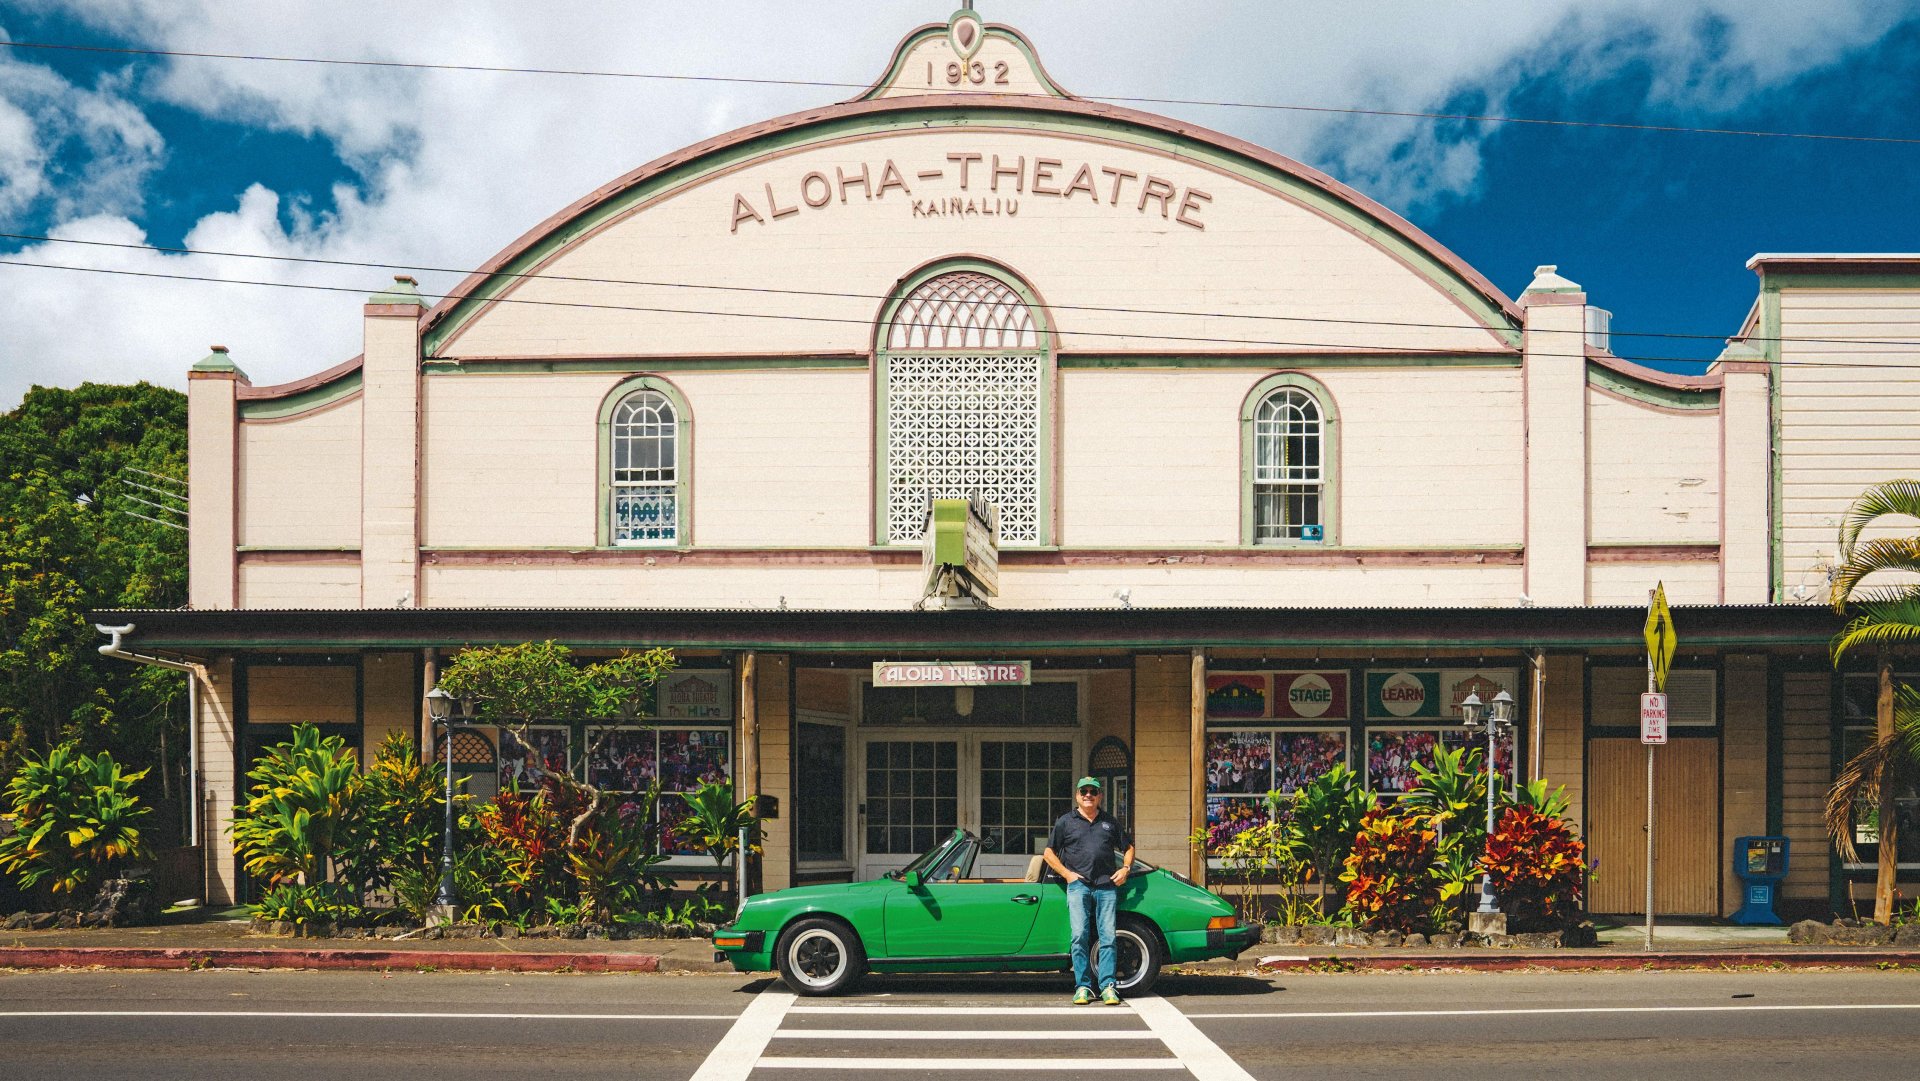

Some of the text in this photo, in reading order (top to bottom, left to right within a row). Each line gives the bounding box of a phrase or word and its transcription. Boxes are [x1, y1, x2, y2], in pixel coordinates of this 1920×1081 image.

[927, 61, 1009, 85] 1932
[911, 197, 1019, 218] KAINALIU
[886, 666, 1018, 682] ALOHA THEATRE
[1289, 688, 1331, 702] STAGE
[1381, 687, 1424, 701] LEARN
[1649, 698, 1659, 708] NO
[1643, 709, 1665, 719] PARKING
